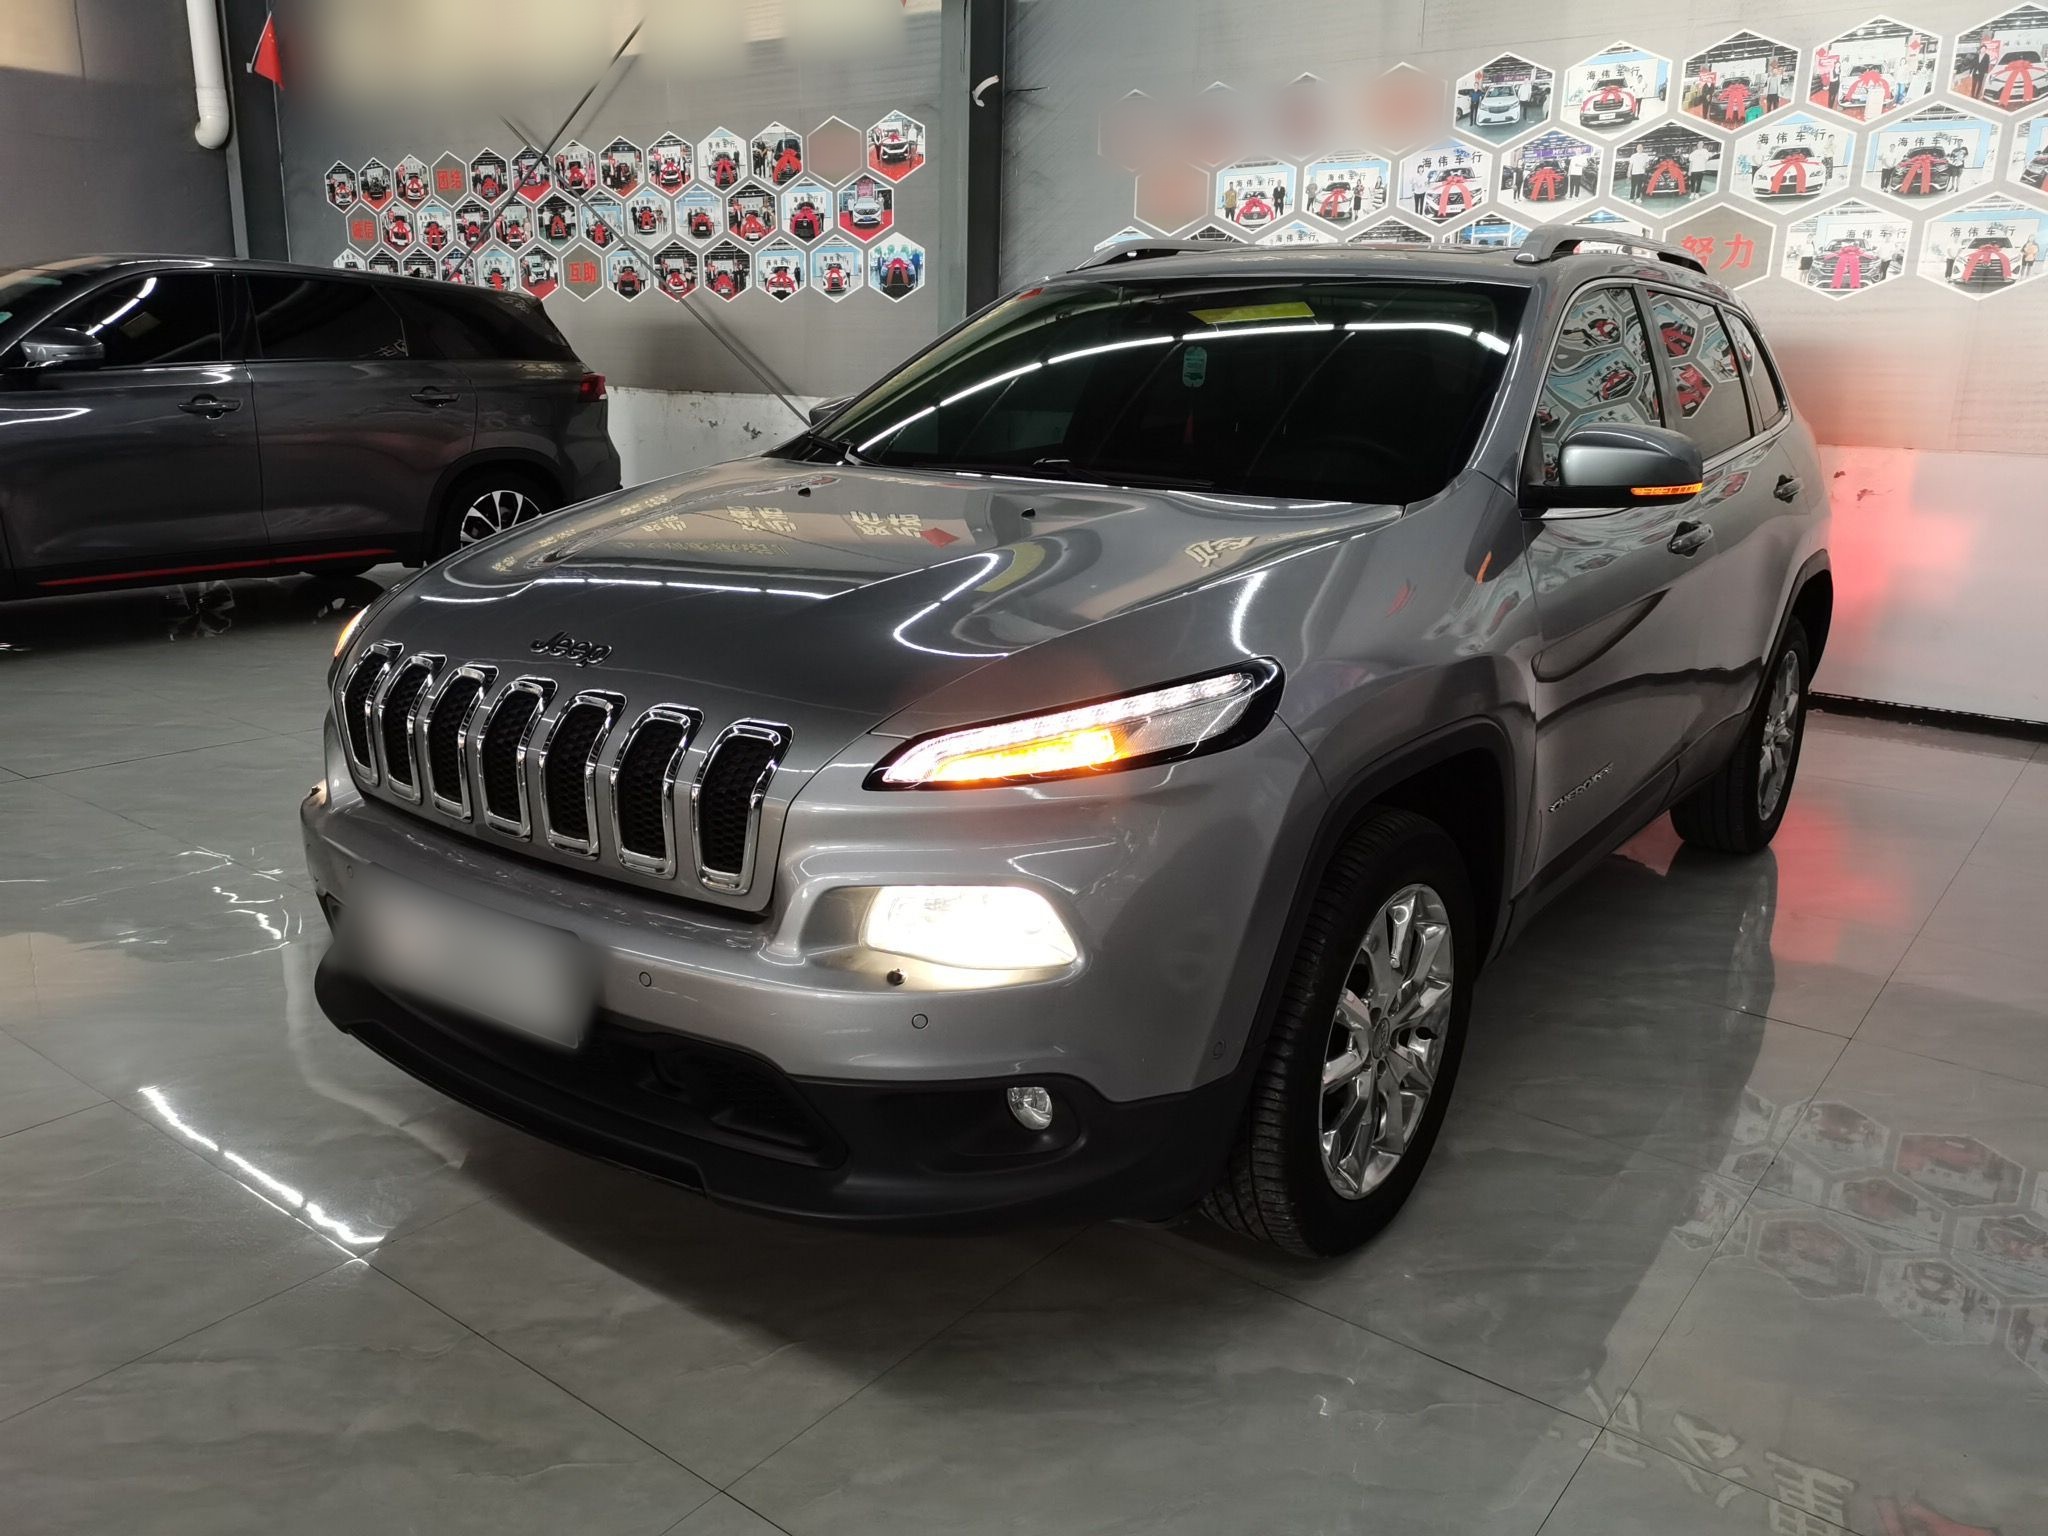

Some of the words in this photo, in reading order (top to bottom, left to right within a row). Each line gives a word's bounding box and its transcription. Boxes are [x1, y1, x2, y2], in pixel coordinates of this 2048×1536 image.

[1586, 66, 1640, 81] 海伟车行
[1758, 128, 1826, 145] 海伟车行
[1898, 134, 1960, 147] 海伟车行
[1422, 151, 1482, 168] 海伟车行
[1950, 225, 2016, 237] 海伟车行
[1681, 232, 1755, 271] 努力
[568, 261, 597, 283] 互助
[530, 631, 613, 667] Jeep
